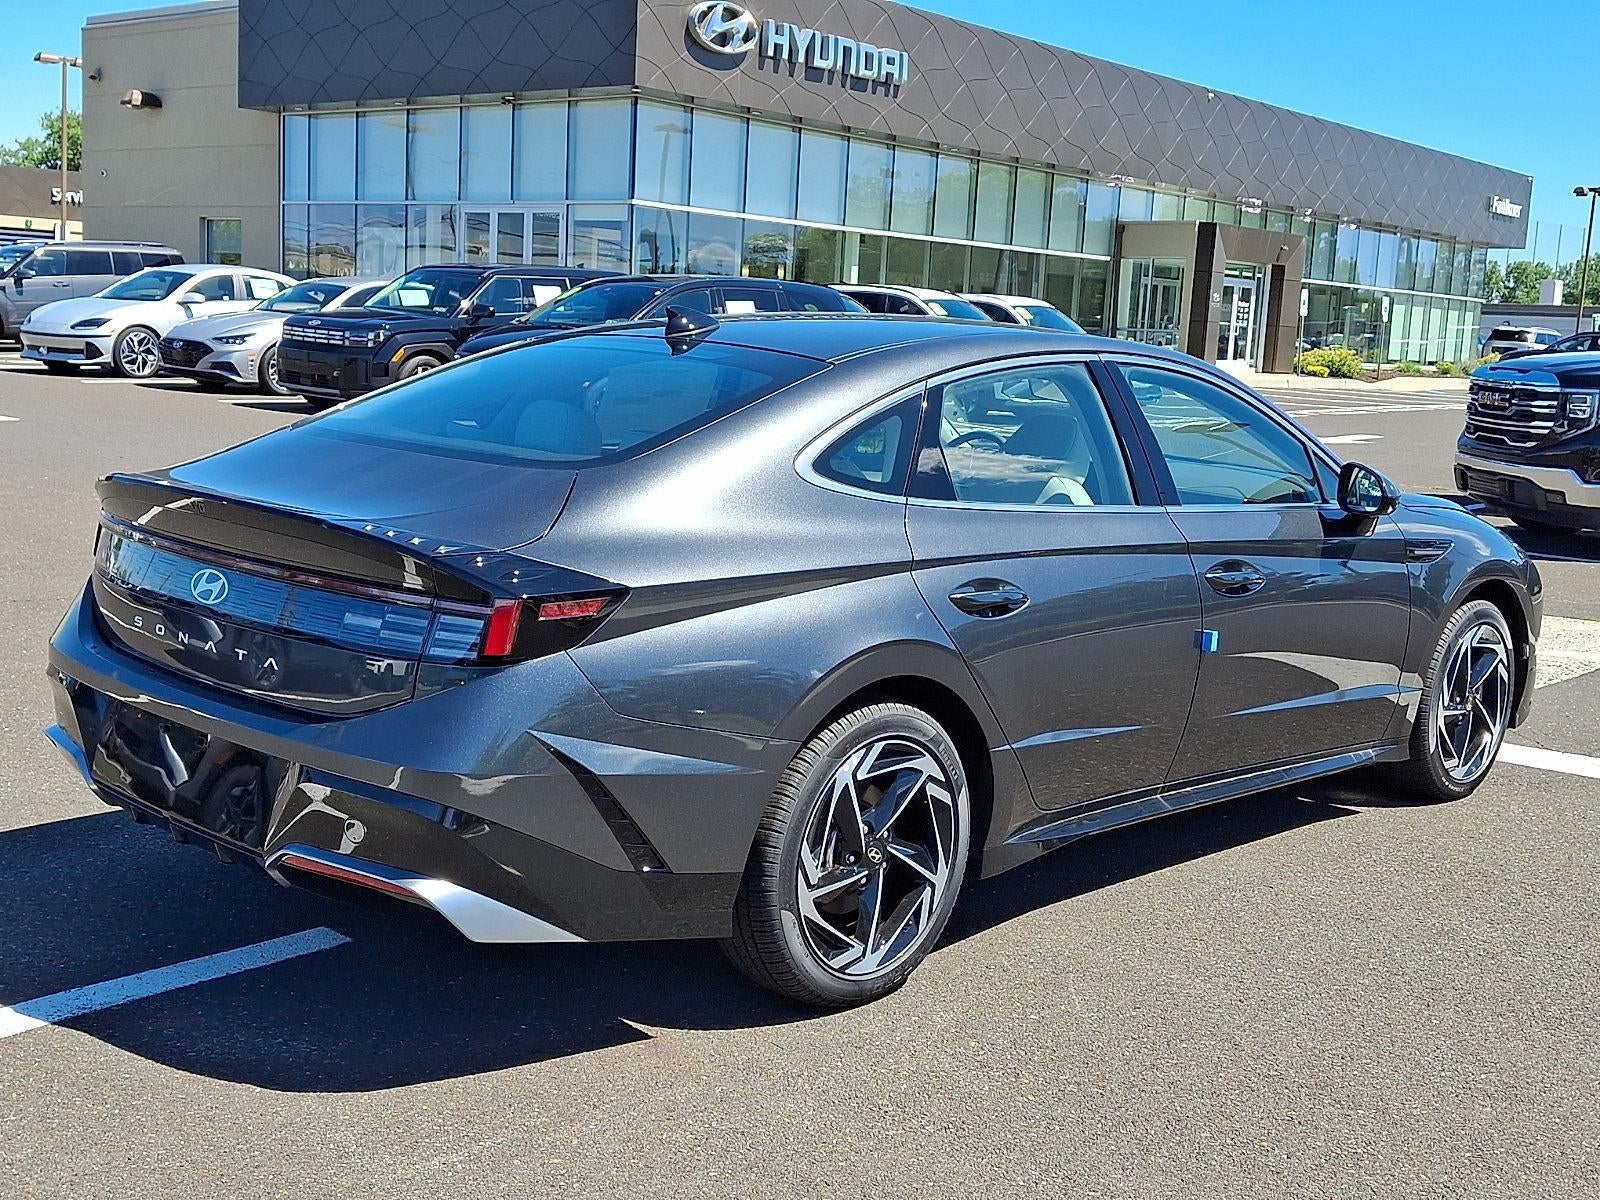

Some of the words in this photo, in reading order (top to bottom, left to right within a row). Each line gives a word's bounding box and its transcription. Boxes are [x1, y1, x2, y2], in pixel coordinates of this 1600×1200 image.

[761, 18, 909, 84] HYUNDAI
[1477, 390, 1510, 407] GMC
[133, 614, 279, 671] SONATA
